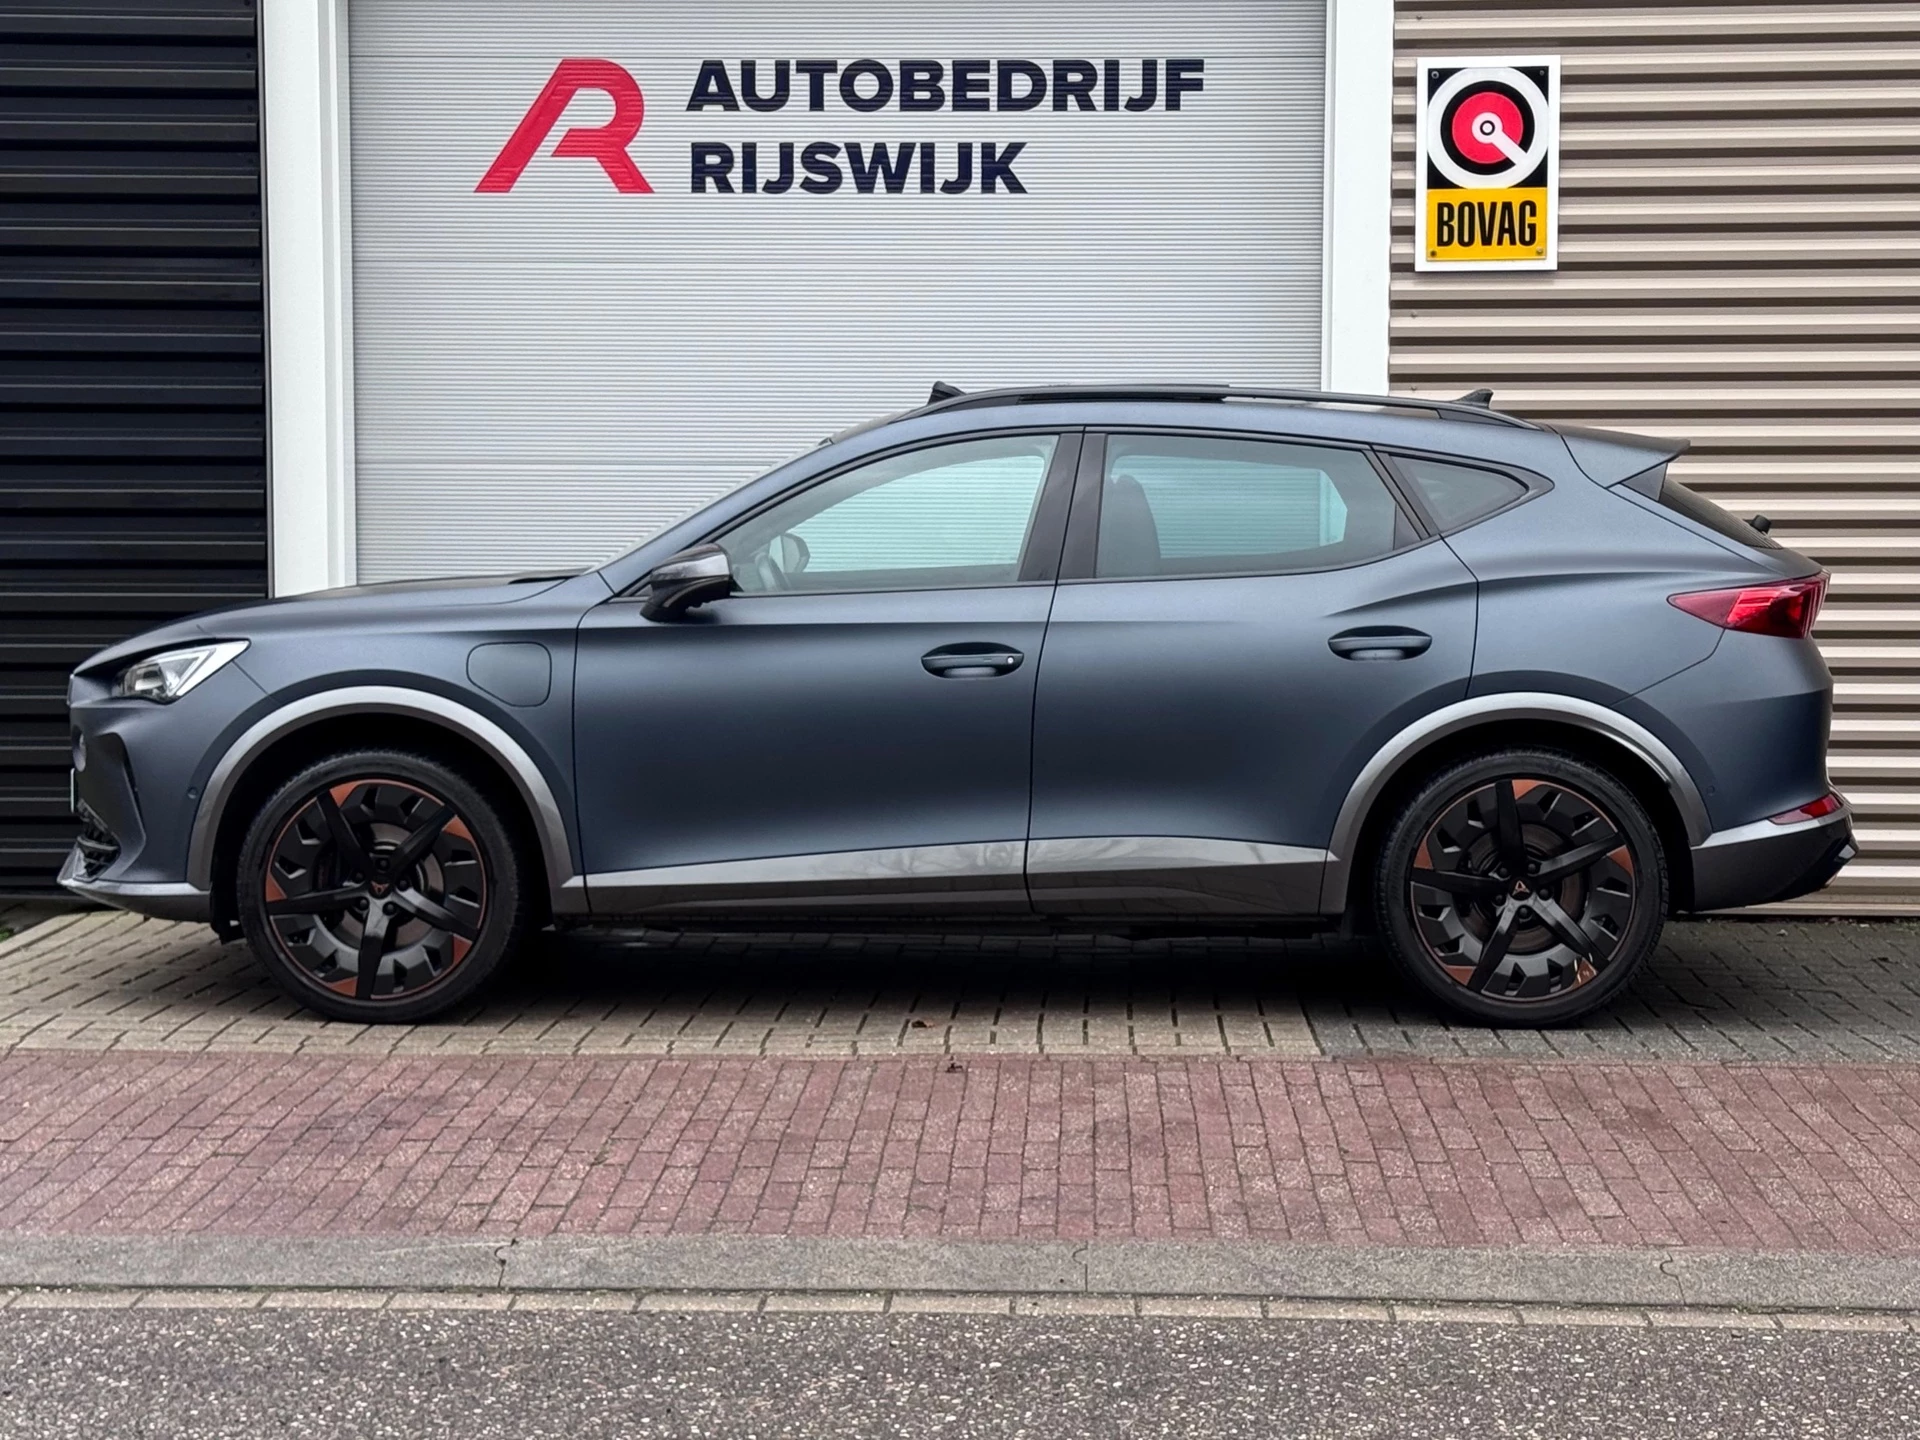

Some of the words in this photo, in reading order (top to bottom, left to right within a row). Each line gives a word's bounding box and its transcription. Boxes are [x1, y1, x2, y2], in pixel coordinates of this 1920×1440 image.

[686, 58, 1205, 113] AUTOBEDRIJF
[690, 142, 1028, 195] RIJSWIJK
[1436, 200, 1537, 247] BOVAG
